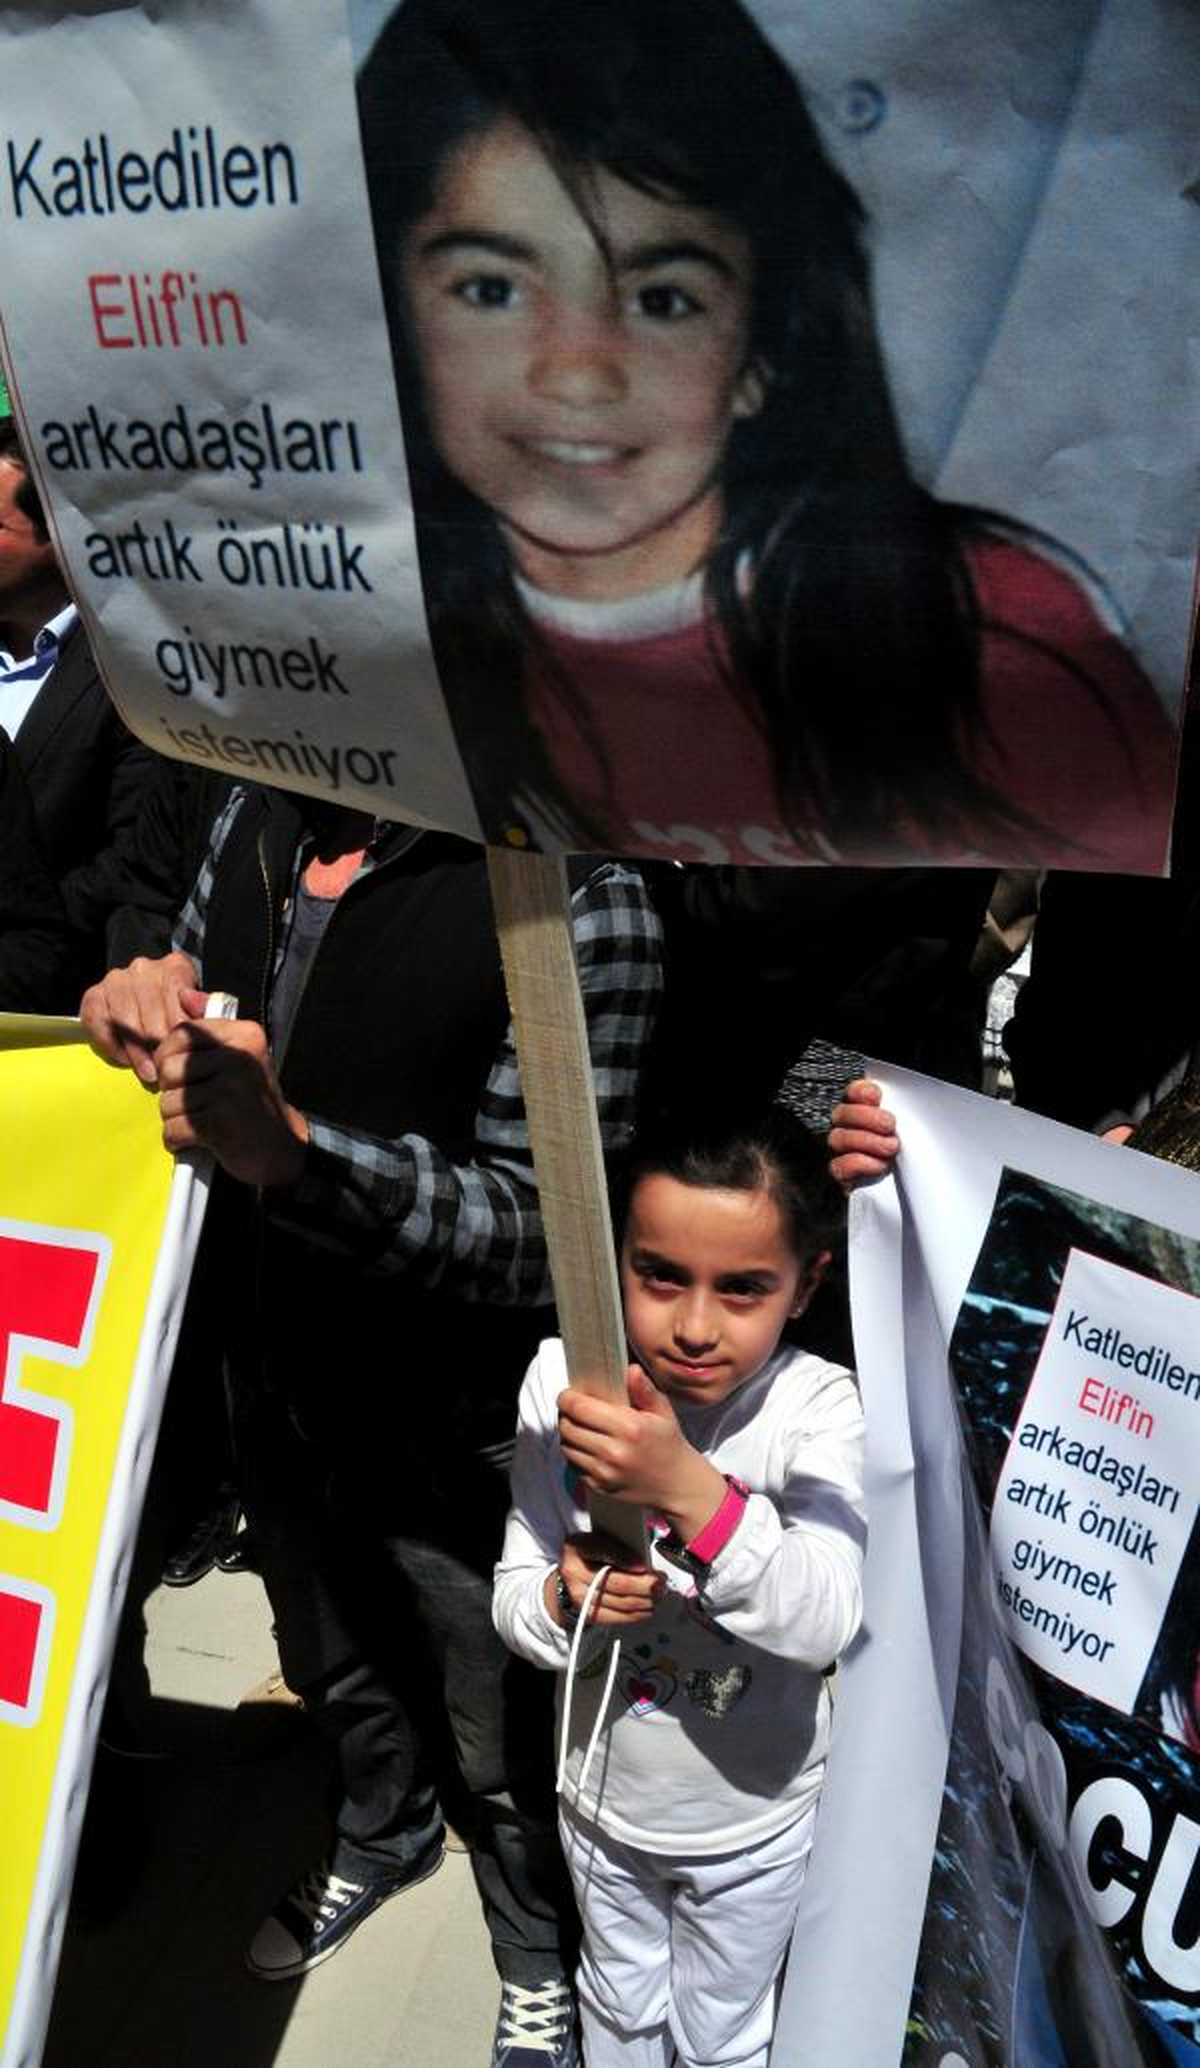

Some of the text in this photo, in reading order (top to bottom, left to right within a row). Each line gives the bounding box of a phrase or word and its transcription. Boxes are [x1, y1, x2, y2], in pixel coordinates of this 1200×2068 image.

[8, 126, 299, 218] Katledilen
[87, 268, 248, 349] Elif'in
[41, 404, 362, 489] arkadaşları
[85, 519, 373, 593] artık önlük
[156, 626, 349, 699] giymek
[160, 716, 398, 790] istemiyor
[1063, 1310, 1200, 1401] Katledilen
[1078, 1377, 1154, 1439] Elif'in
[1019, 1422, 1181, 1513] arkadaşları
[1007, 1477, 1159, 1565] artık önlük
[1012, 1540, 1117, 1606] giymek
[998, 1570, 1115, 1662] istemiyor
